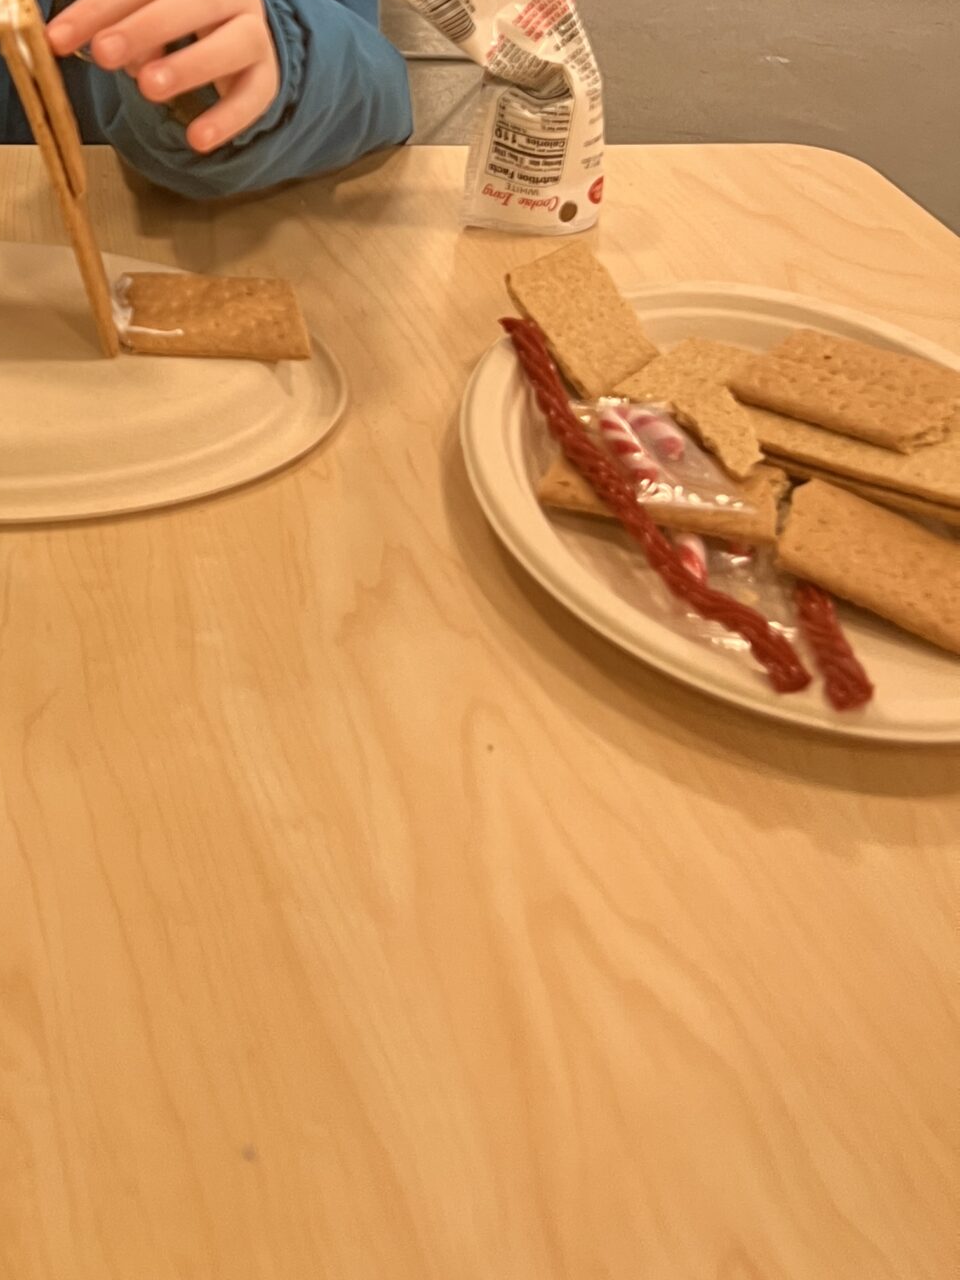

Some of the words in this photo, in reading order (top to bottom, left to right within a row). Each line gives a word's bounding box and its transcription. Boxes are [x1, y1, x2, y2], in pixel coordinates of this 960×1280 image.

[494, 127, 517, 144] 110
[526, 136, 566, 147] Calories
[488, 163, 515, 179] Facts
[517, 172, 560, 185] Nutrition
[481, 183, 515, 207] Icing
[504, 181, 541, 197] WHITE
[518, 195, 560, 212] Cookie
